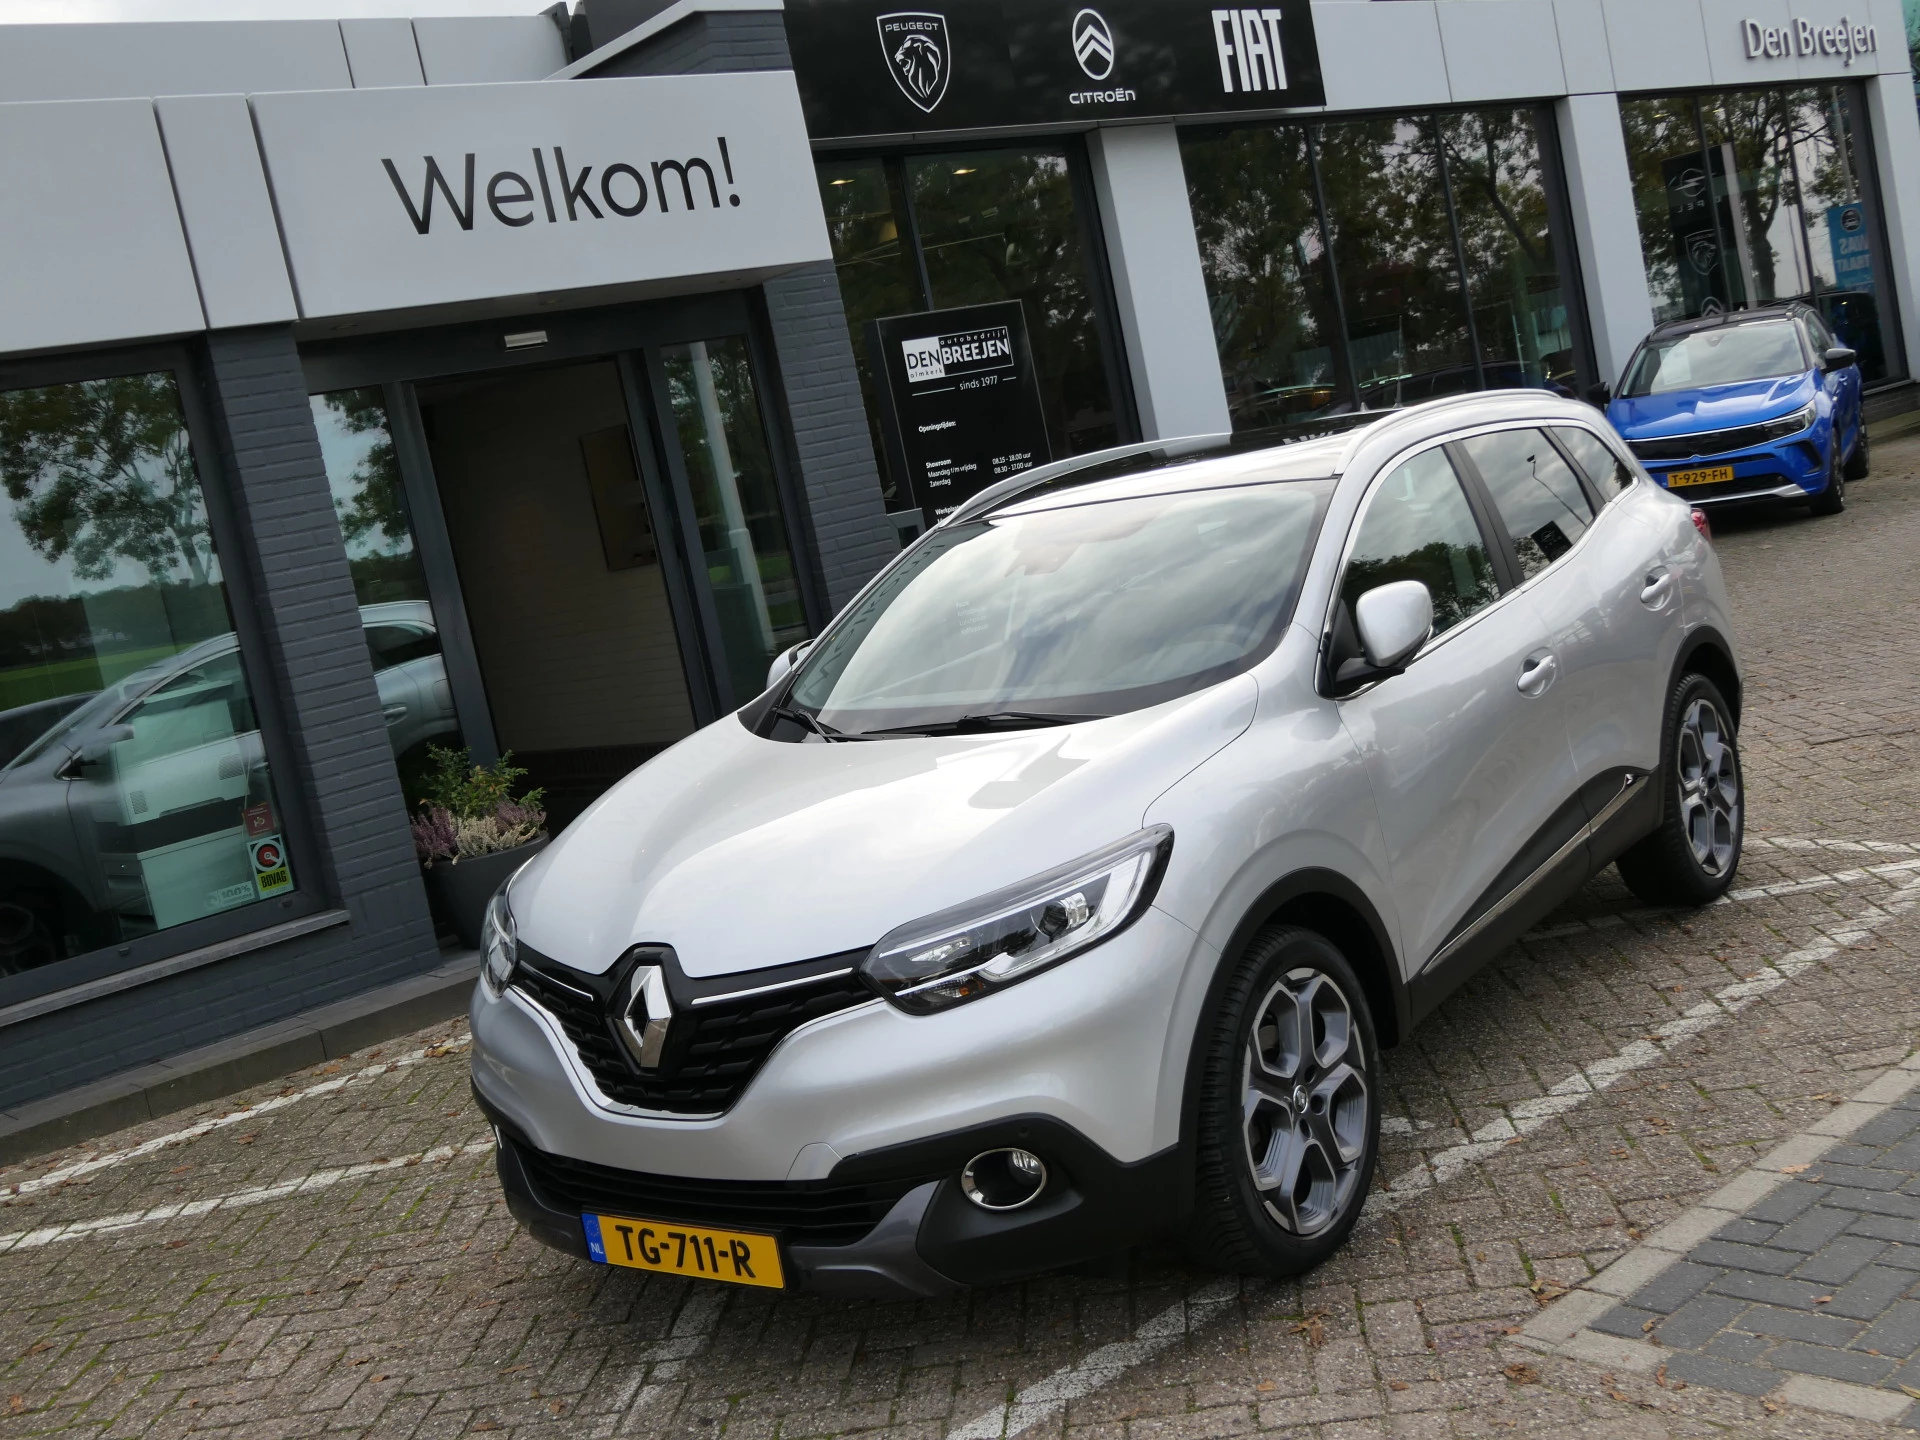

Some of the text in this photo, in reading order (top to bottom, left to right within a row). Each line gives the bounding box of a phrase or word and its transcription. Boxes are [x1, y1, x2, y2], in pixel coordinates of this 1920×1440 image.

[884, 22, 939, 33] PEUGEOT
[1741, 15, 1879, 67] Den Breejen
[1211, 9, 1289, 93] FIAT
[381, 137, 741, 235] Welkom!
[940, 329, 1006, 345] autobedrijf
[906, 338, 1010, 369] DEN BREEJEN
[959, 375, 998, 391] sinds 1977
[1671, 468, 1728, 485] T-929-FH
[261, 870, 287, 888] BOVAG
[590, 1242, 604, 1254] NL
[615, 1224, 756, 1279] TG-711-R
